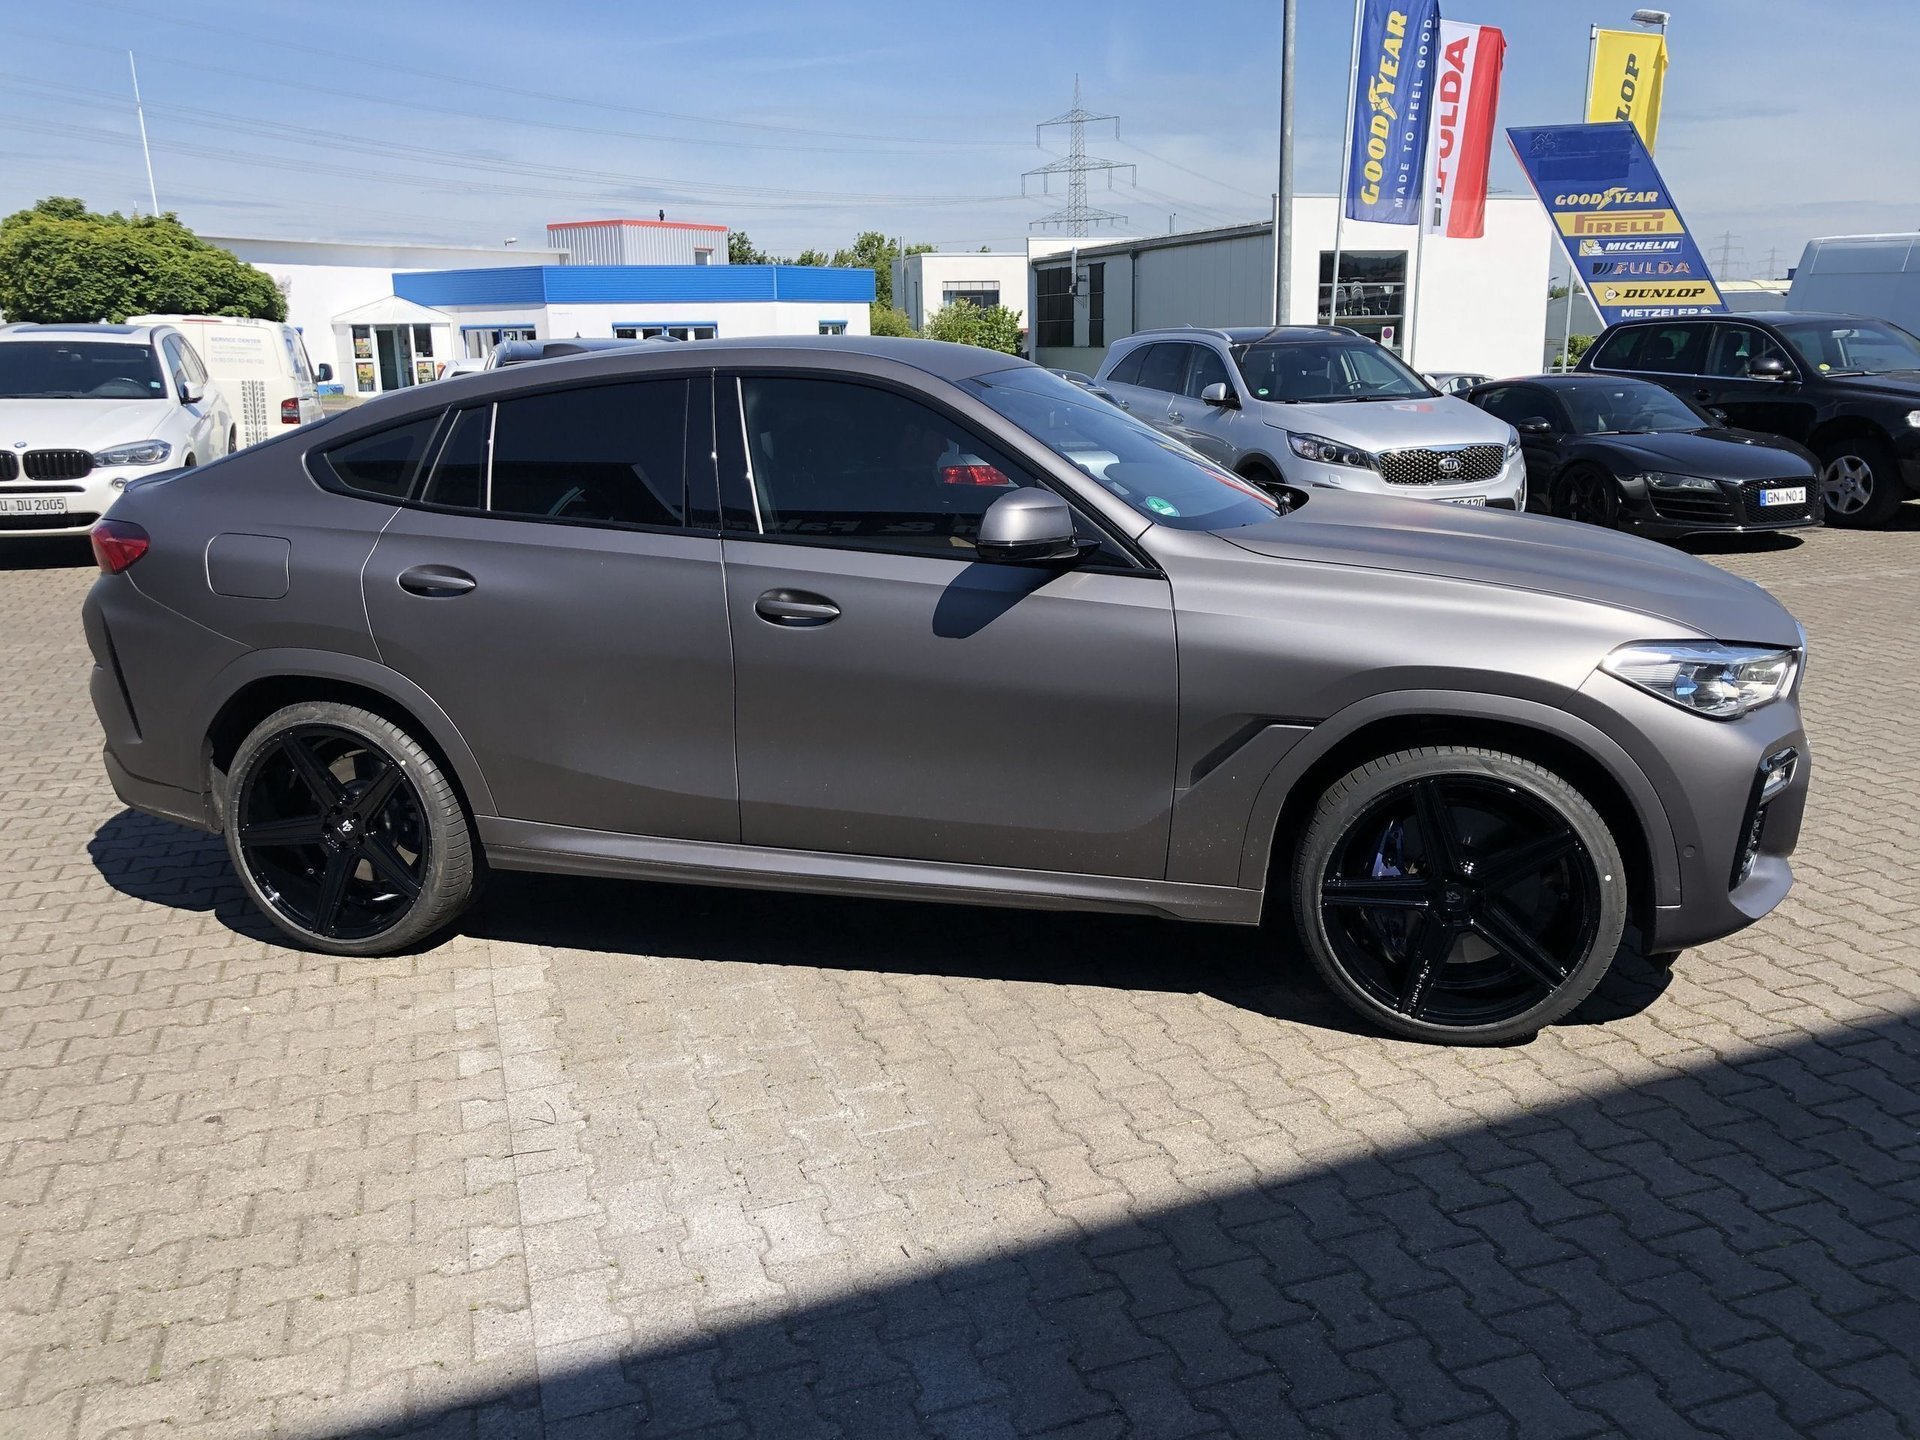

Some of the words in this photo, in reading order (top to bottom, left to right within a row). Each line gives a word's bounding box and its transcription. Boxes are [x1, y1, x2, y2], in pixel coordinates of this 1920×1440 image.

[1361, 10, 1408, 206] GOODYEAR
[1408, 79, 1423, 121] FEEL
[1403, 131, 1415, 153] TO
[1394, 162, 1410, 208] MADE
[1554, 187, 1659, 210] GOODYEAR
[1574, 211, 1666, 234] PIRELLI
[1605, 240, 1679, 251] MICHELIN
[1612, 260, 1691, 276] FULDA
[1623, 288, 1706, 299] DUNLOP
[1443, 461, 1458, 470] KIA
[16, 500, 32, 511] DU
[34, 499, 65, 511] 2005
[1767, 491, 1780, 503] GN
